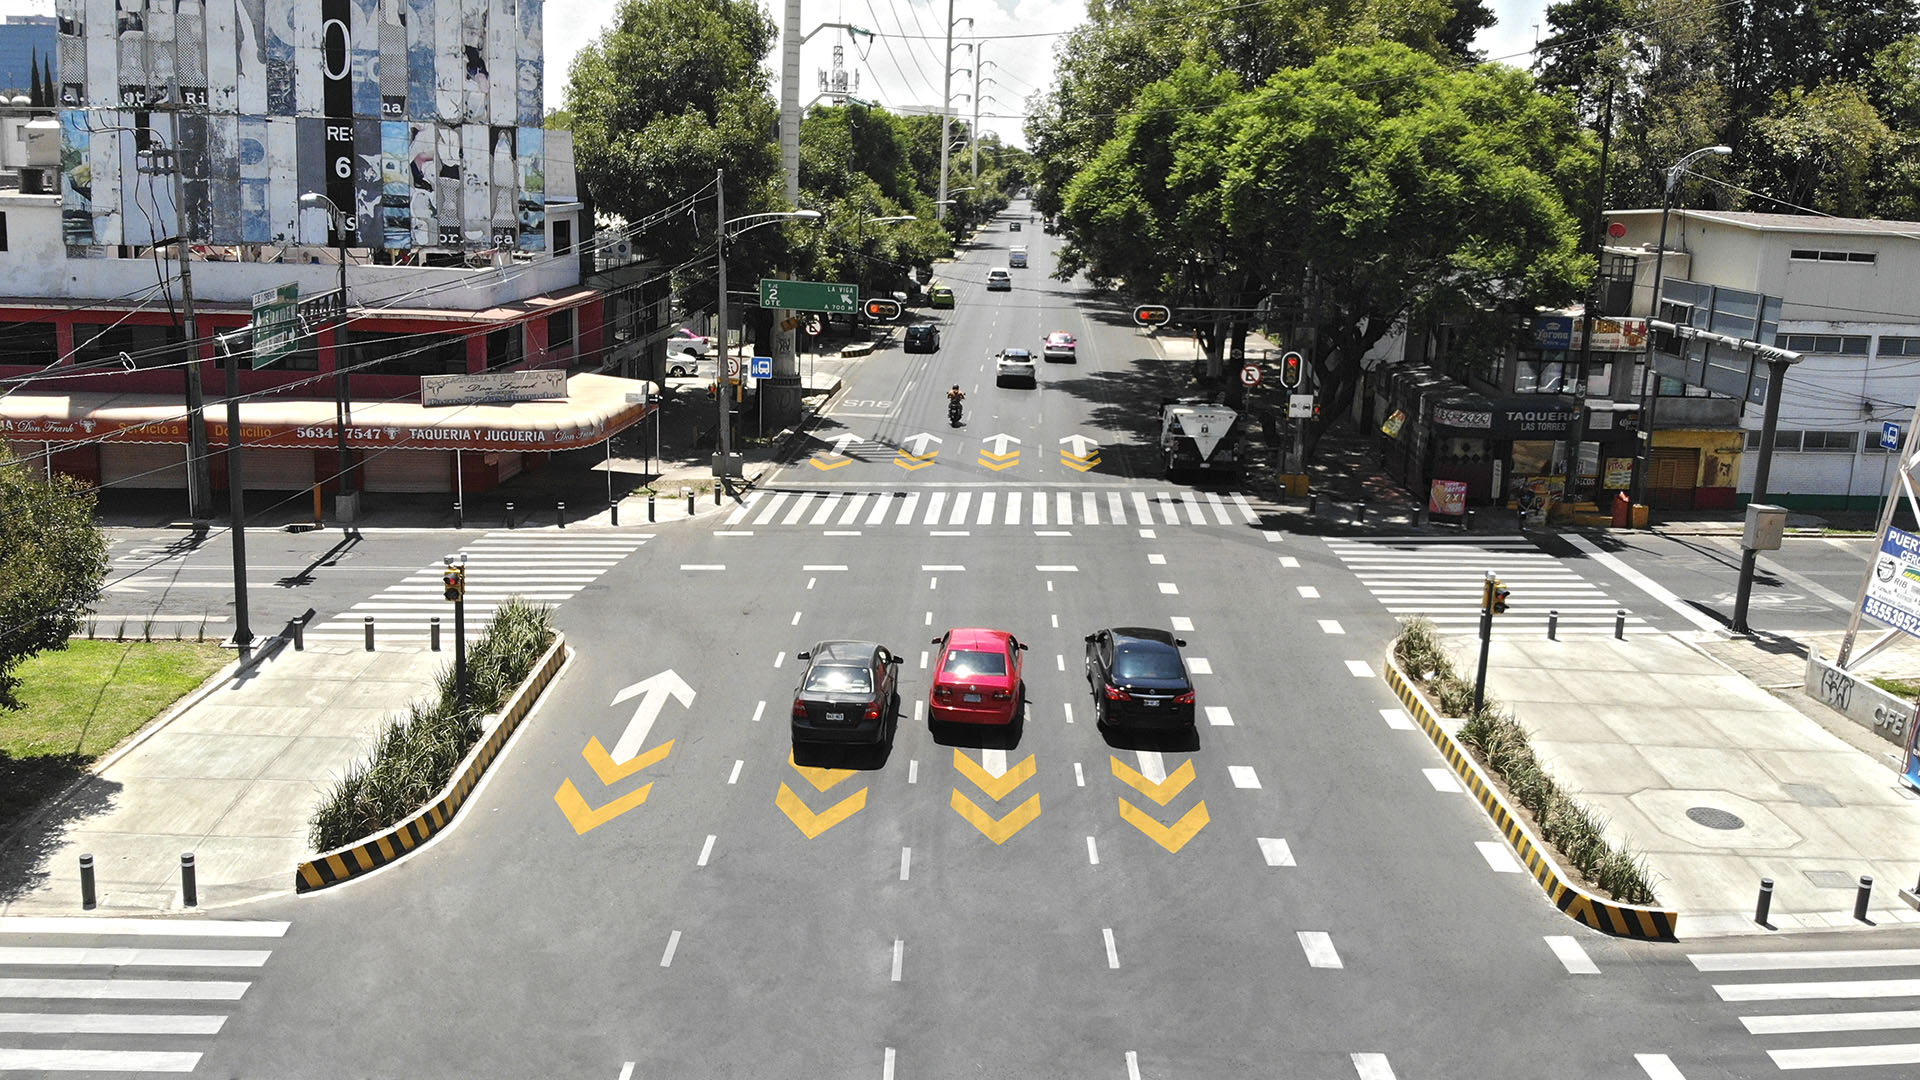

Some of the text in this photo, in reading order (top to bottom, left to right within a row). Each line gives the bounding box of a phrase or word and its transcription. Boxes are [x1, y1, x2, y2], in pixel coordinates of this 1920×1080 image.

[769, 288, 778, 300] 2
[764, 299, 781, 307] OTE
[1506, 411, 1579, 421] TAQUERI
[118, 422, 179, 435] Servicio a
[215, 424, 272, 438] Doicilio
[1521, 422, 1567, 432] LAS TORRES
[409, 428, 545, 443] TAQUERIA Y JUGUERIA
[1873, 703, 1907, 736] CFE
